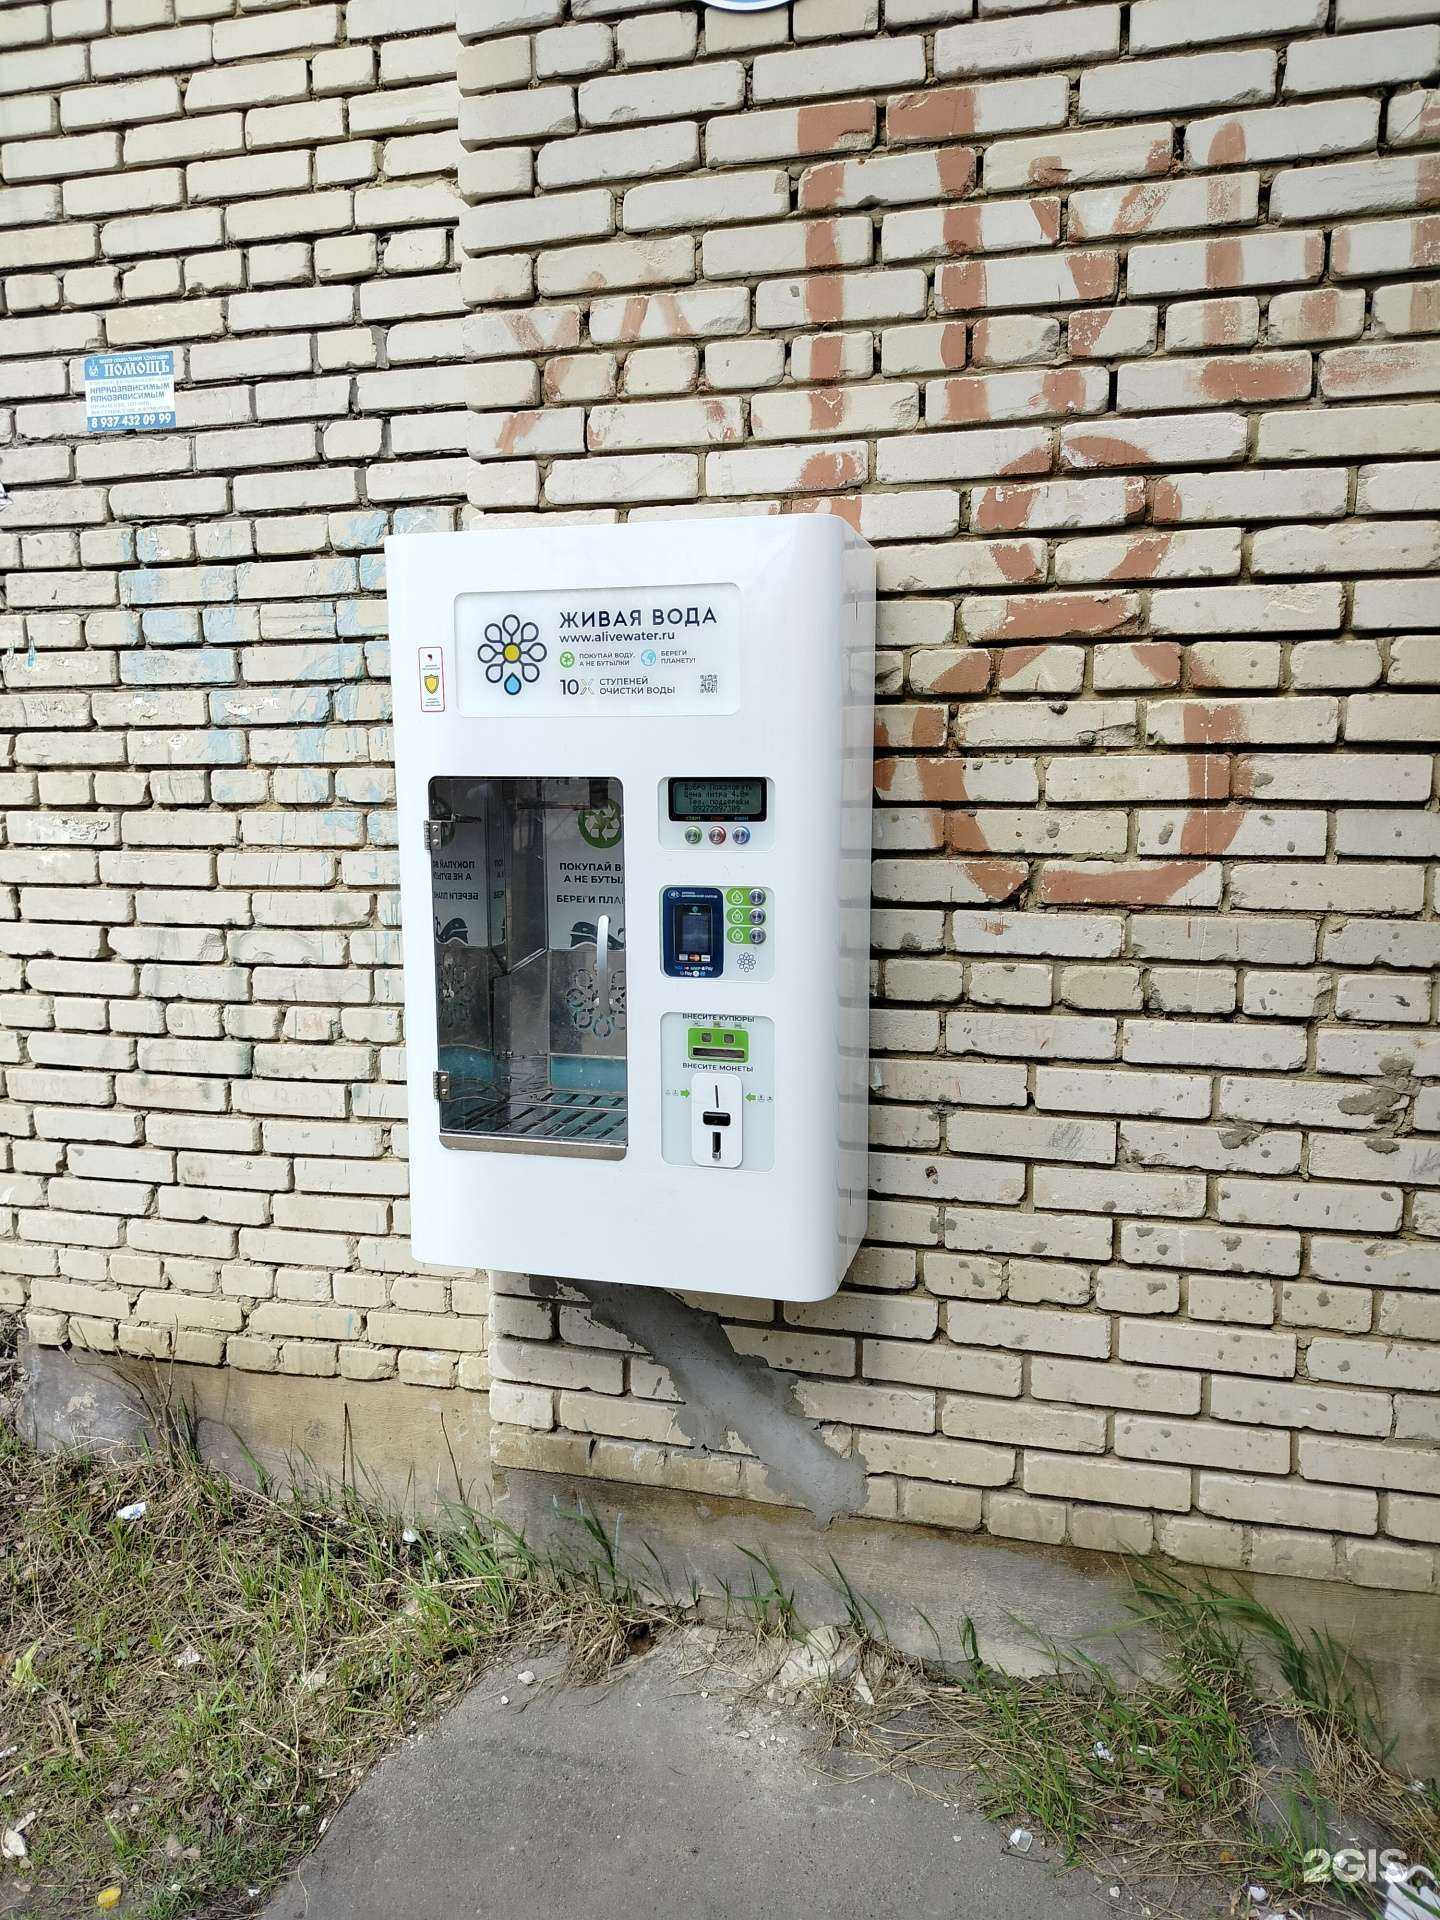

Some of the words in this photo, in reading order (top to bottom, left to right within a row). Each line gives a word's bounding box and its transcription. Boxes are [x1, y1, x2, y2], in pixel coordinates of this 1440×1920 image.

[90, 382, 170, 394] НАРКОЗАВИСИМЫМ
[91, 392, 165, 403] АЛКОЗАВИСИМЫМ
[91, 418, 98, 428] 8
[100, 416, 120, 427] 937
[122, 415, 141, 426] 432
[143, 413, 156, 425] 09
[158, 413, 172, 424] 99
[559, 609, 642, 629] ЖИВАЯ
[652, 606, 717, 627] ВОДА
[559, 631, 675, 643] www.alivewater.ru
[579, 651, 613, 659] ПОКУПАЙ
[661, 657, 696, 665] ПЛАНЕТУ!
[599, 676, 649, 686] СТУПЕНЕЙ
[599, 686, 643, 695] ОЧИСТКИ
[647, 686, 675, 695] ВОДЫ
[559, 861, 612, 872] ПОКУПАЙ
[614, 863, 624, 872] В
[563, 875, 571, 883] А
[574, 875, 588, 883] НЕ
[556, 895, 596, 903] БЕРЕГИ
[682, 1012, 717, 1021] ВНЕСИТЕ
[719, 1013, 755, 1022] КУПЮРЫ
[682, 1062, 717, 1071] ВНЕСИТЕ
[719, 1064, 754, 1072] МОНЕТЫ
